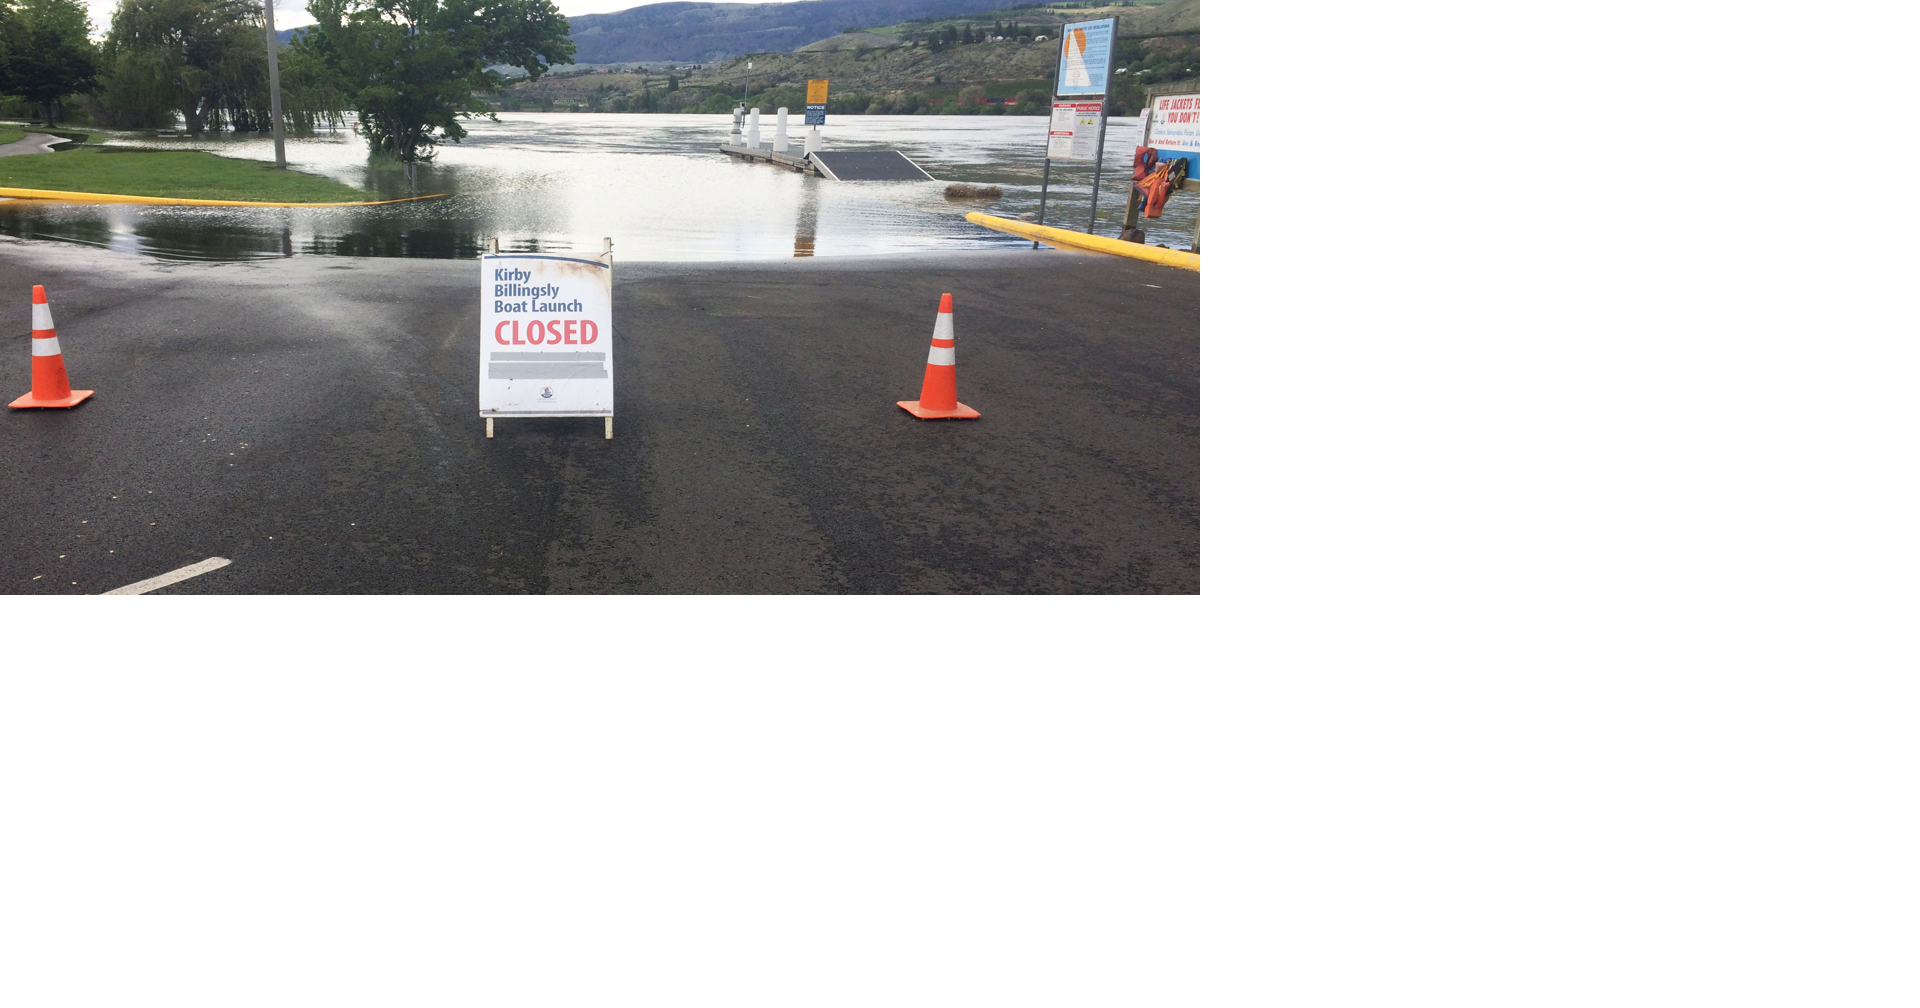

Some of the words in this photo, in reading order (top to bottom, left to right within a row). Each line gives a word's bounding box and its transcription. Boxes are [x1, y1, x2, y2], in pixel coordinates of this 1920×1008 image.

[1159, 99, 1170, 110] LIFE
[1170, 98, 1193, 110] JACKETS
[1167, 112, 1179, 123] YOU
[1179, 112, 1200, 123] DON'T!
[494, 268, 531, 284] Kirby
[494, 283, 560, 300] Billingsly
[494, 300, 528, 313] Boat
[532, 299, 583, 312] Launch
[494, 320, 599, 345] CLOSED
